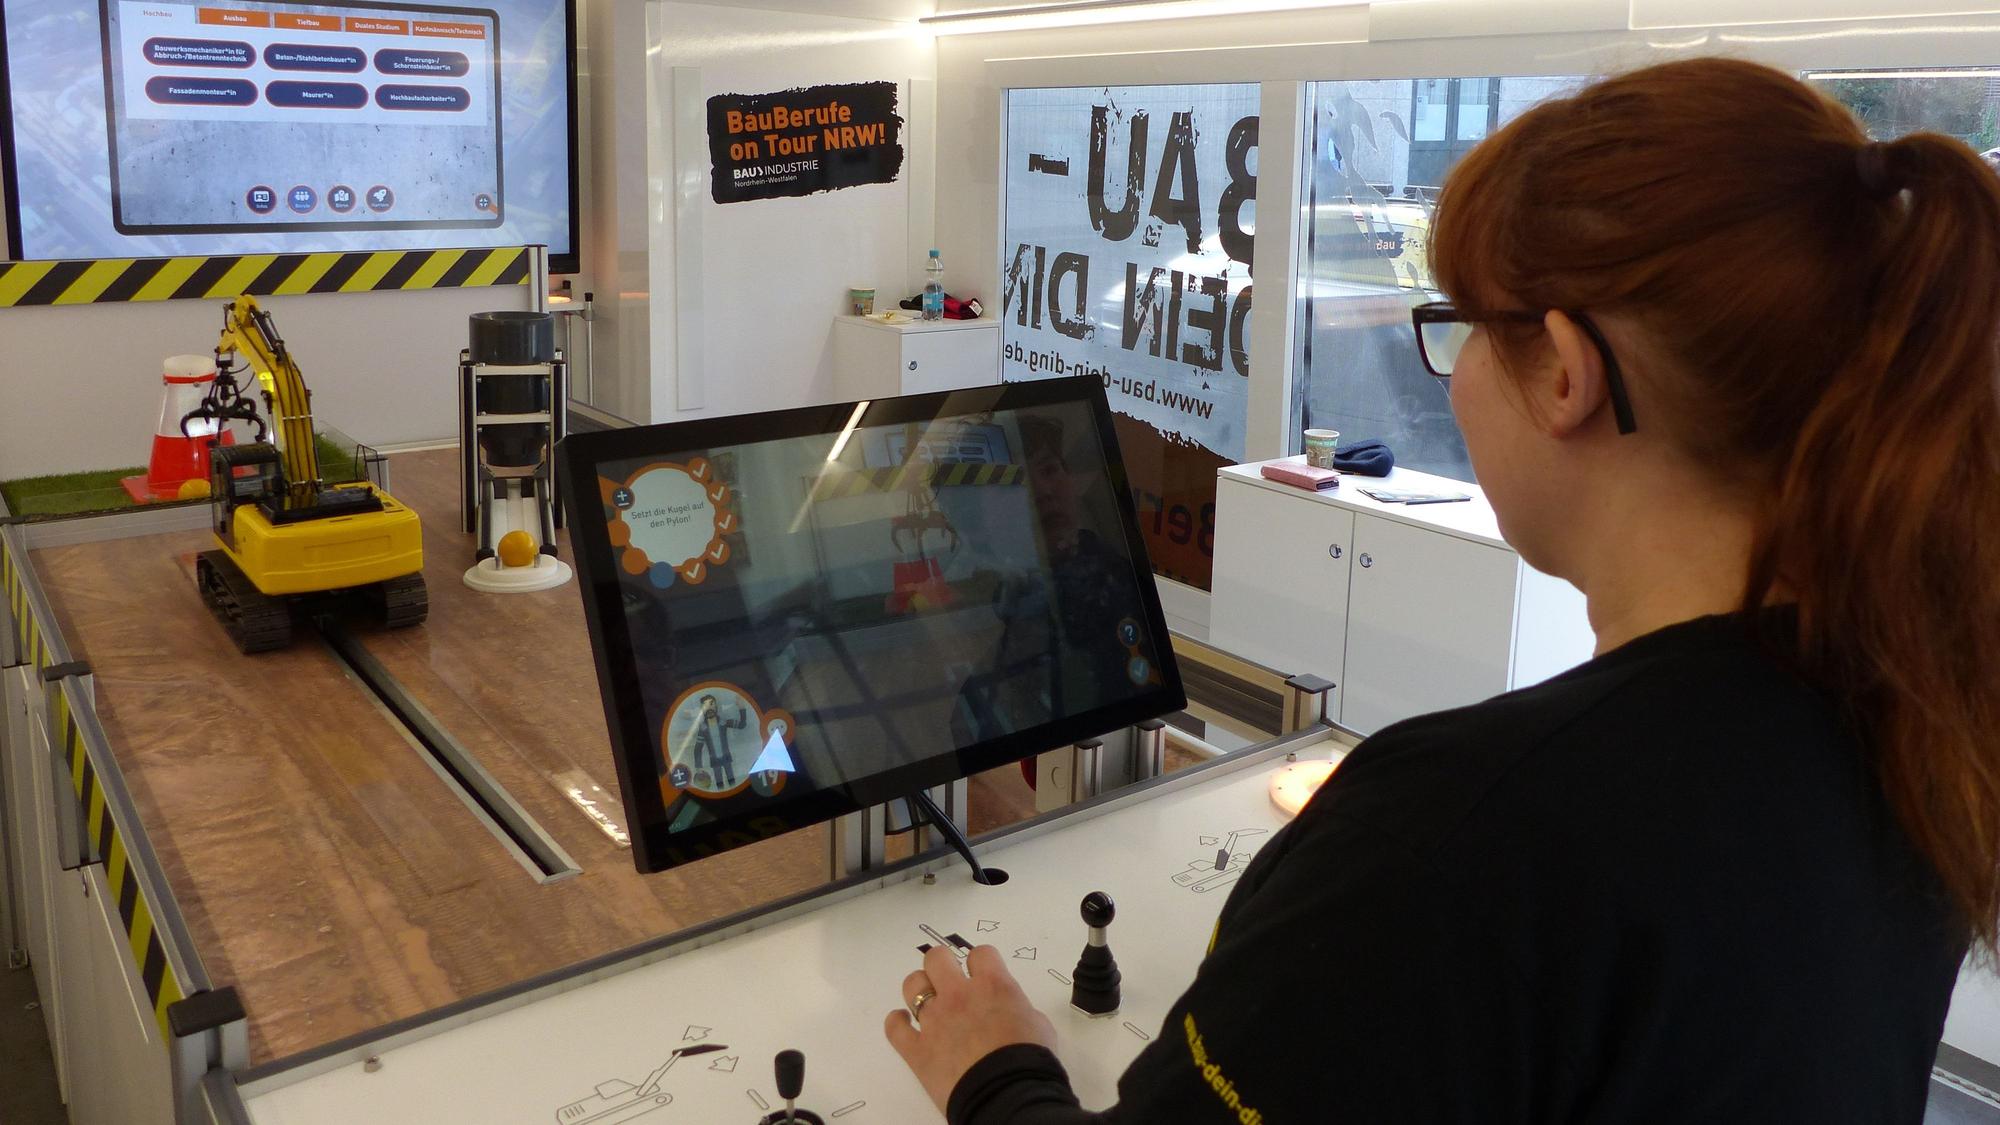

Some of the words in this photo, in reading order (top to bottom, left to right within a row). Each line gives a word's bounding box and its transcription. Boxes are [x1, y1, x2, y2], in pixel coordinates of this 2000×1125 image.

[223, 14, 248, 23] Ausbau
[296, 18, 320, 27] Tiefbau
[355, 22, 375, 30] Duales
[375, 23, 400, 31] Studium
[235, 48, 246, 56] für
[726, 101, 851, 134] BauBerufe
[730, 142, 759, 161] on
[764, 134, 818, 157] Tour
[823, 123, 886, 151] NRW!
[734, 174, 798, 188] Nordrhein-Westfalen
[631, 509, 652, 520] Setzt
[653, 505, 666, 516] die
[667, 503, 690, 516] Kugel
[692, 501, 705, 511] auf
[650, 519, 665, 529] den
